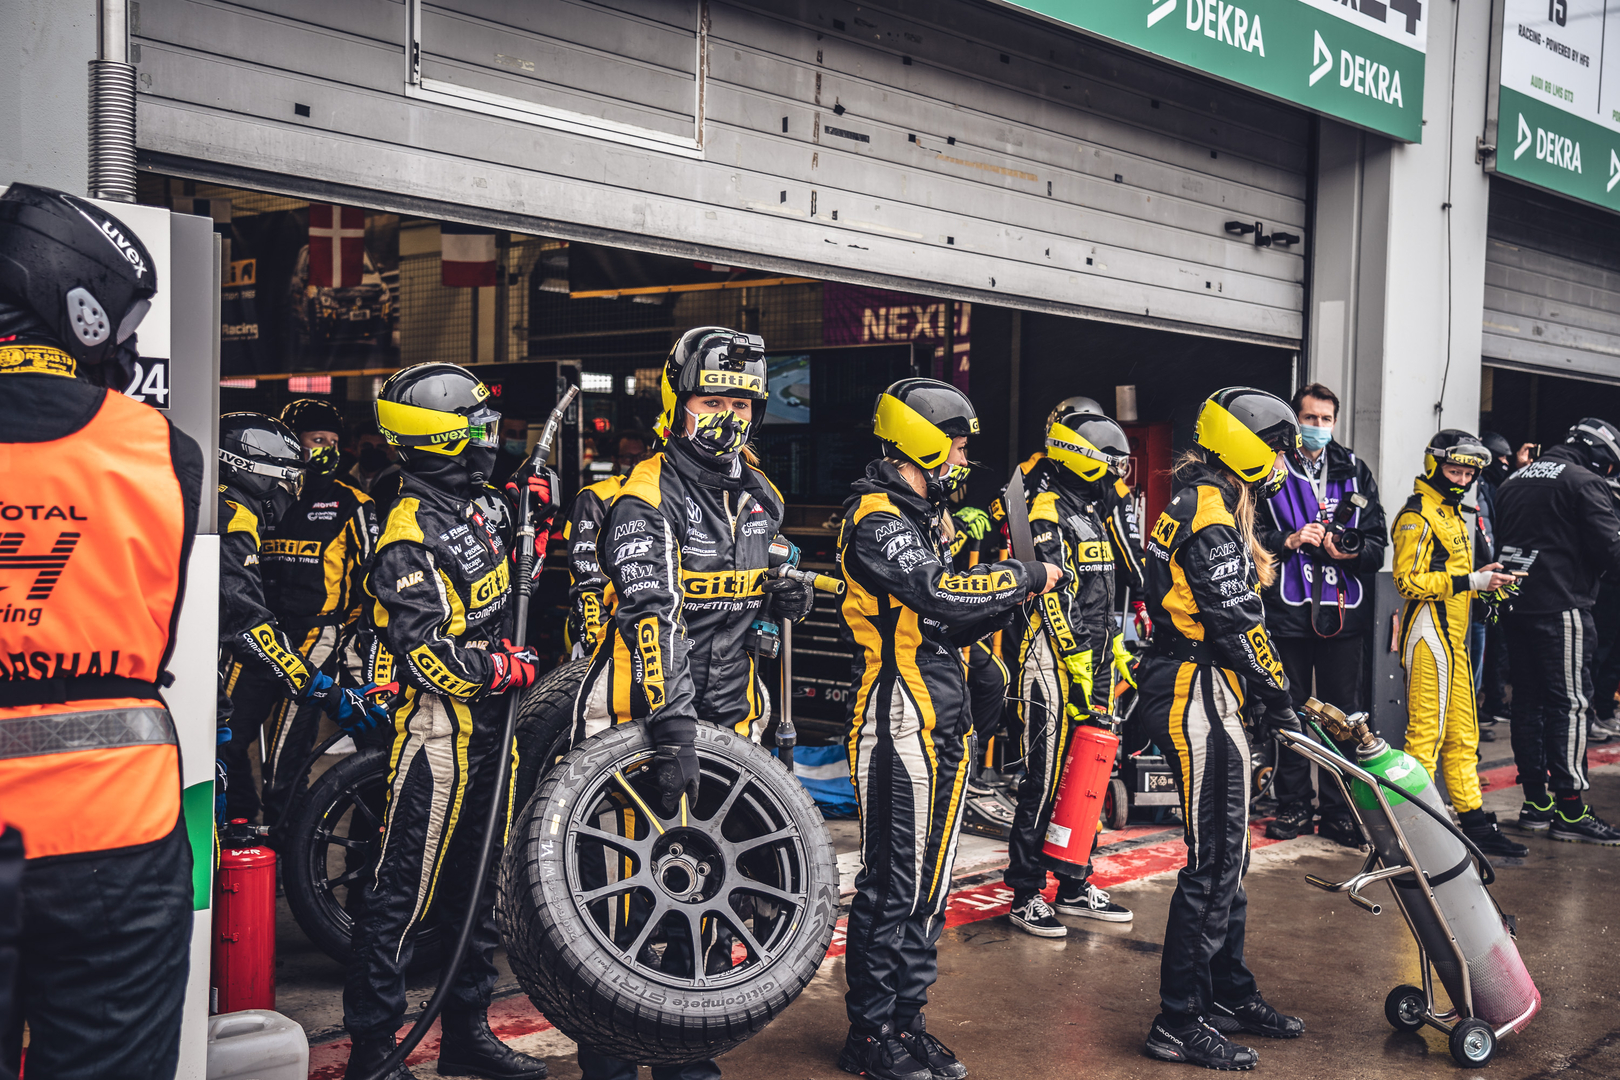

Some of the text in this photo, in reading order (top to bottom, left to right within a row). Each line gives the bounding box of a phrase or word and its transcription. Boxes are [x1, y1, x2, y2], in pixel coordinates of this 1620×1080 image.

[1186, 0, 1265, 57] DEKRA
[1518, 24, 1541, 45] RACEING
[1546, 37, 1571, 59] POWERED
[1572, 51, 1579, 62] BY
[1580, 54, 1590, 68] HFG
[1340, 49, 1403, 108] DEKRA
[1530, 75, 1544, 91] AUDI
[1553, 83, 1564, 99] LMS
[1564, 89, 1574, 103] GT3
[1536, 127, 1582, 174] DEKRA
[101, 221, 147, 279] uvex
[124, 362, 169, 404] 24
[704, 373, 744, 386] Giti
[430, 428, 468, 444] uvex
[1053, 439, 1083, 454] uvex
[0, 502, 88, 521] OTAL
[263, 542, 295, 556] Giti
[684, 575, 745, 595] Giti
[945, 578, 988, 591] Giti
[1303, 563, 1338, 585] 68
[935, 591, 992, 604] COMPETITION
[1046, 597, 1065, 631] Giti
[243, 632, 284, 678] COMPETITION
[258, 629, 296, 670] Giti
[641, 623, 659, 678] Giti
[1251, 632, 1273, 670] Giti
[418, 653, 460, 695] Giti
[672, 981, 775, 1010] GitiCompete
